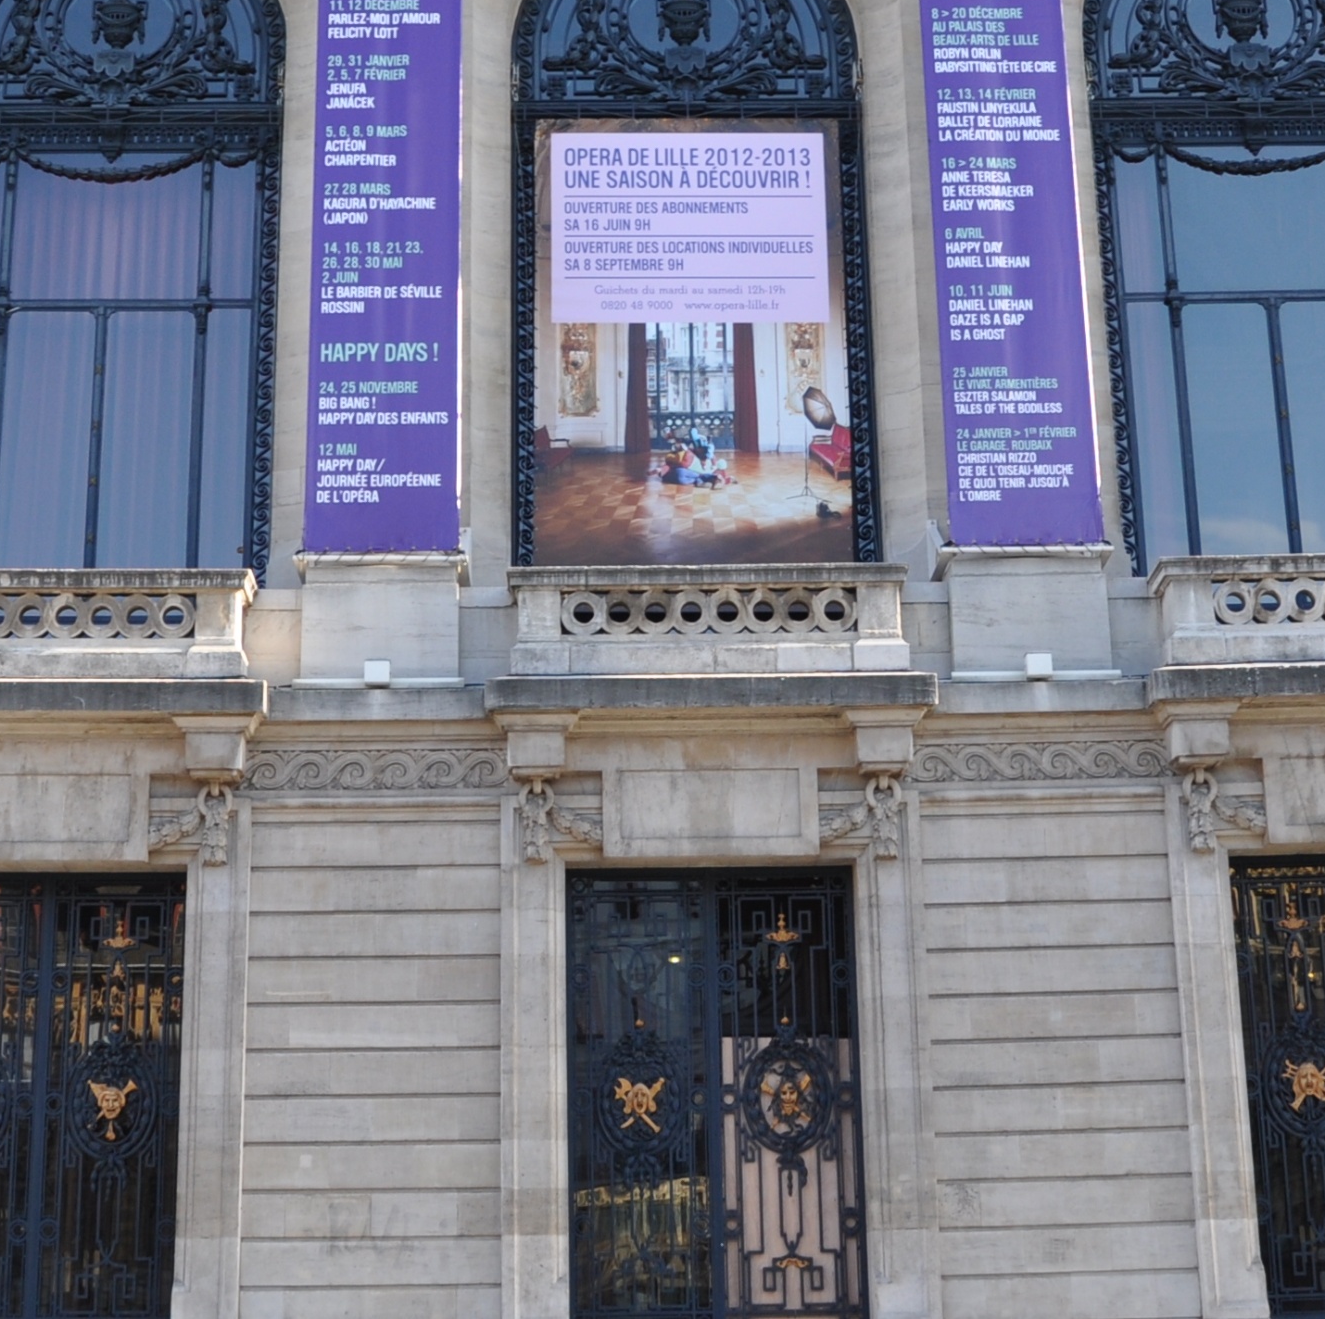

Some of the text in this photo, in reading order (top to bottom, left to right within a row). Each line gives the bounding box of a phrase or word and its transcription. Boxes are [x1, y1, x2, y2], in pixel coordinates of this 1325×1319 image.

[328, 13, 440, 25] PARLEZ-MOI D'AMOUR
[328, 27, 398, 39] FELICITY LOTT
[932, 21, 1005, 33] AU PALAIS DES
[934, 34, 1039, 46] BEAUX-ARTS DE LILLE
[934, 48, 1001, 59] ROBYN ORLIN
[327, 83, 367, 95] JENUFA
[937, 102, 1036, 114] FAUSTIN LINYEKULA
[324, 138, 366, 151] ACTÉON
[324, 154, 396, 166] CHARPENTIER
[564, 148, 811, 167] OPERA DE LILLE 2012-2013
[564, 170, 600, 188] UNE
[606, 170, 673, 188] SAISON
[679, 167, 691, 188] À
[697, 167, 800, 188] DÉCOUVRIR
[941, 171, 1010, 183] ANNE TERESA
[942, 185, 1033, 197] DE KEERSMAEKER
[324, 197, 436, 209] KAGURA D'HAYACHINE
[564, 202, 748, 214] OUVERTURE DES ABONNEMENTS
[943, 199, 1015, 211] EARLY WORKS
[324, 212, 368, 224] (JAPON)
[564, 219, 651, 231] SA 16 JUIN 9H
[564, 241, 813, 254] OUVERTURE DES LOCATIONS INDIVIDUELLES
[945, 242, 1003, 253] HAPPY DAY
[564, 258, 684, 271] SA 8 SEPTEMBRE 9H
[946, 256, 1030, 268] DANIEL LINEHAN
[321, 284, 442, 298] LE BARBIER DE SÉVILLE
[594, 284, 786, 295] Guichets du mardi au samedi 12h-19h
[321, 301, 365, 313] ROSSINI
[601, 299, 780, 313] 0820 48 9000 www.opera-lille.fr
[949, 299, 1033, 311] DANIEL LINEHAN
[321, 343, 380, 362] HAPPY
[385, 343, 428, 362] DAYS
[954, 391, 1036, 402] ESZTER SALAMON
[318, 412, 448, 424] HAPPY DAY DES ENFANTS
[958, 452, 1036, 463] CHRISTIAN RIZZO
[317, 459, 354, 471] HAPPY
[316, 472, 442, 487] JOURNÉE EUROPÉENNE
[316, 489, 379, 503] DE L'OPÉRA
